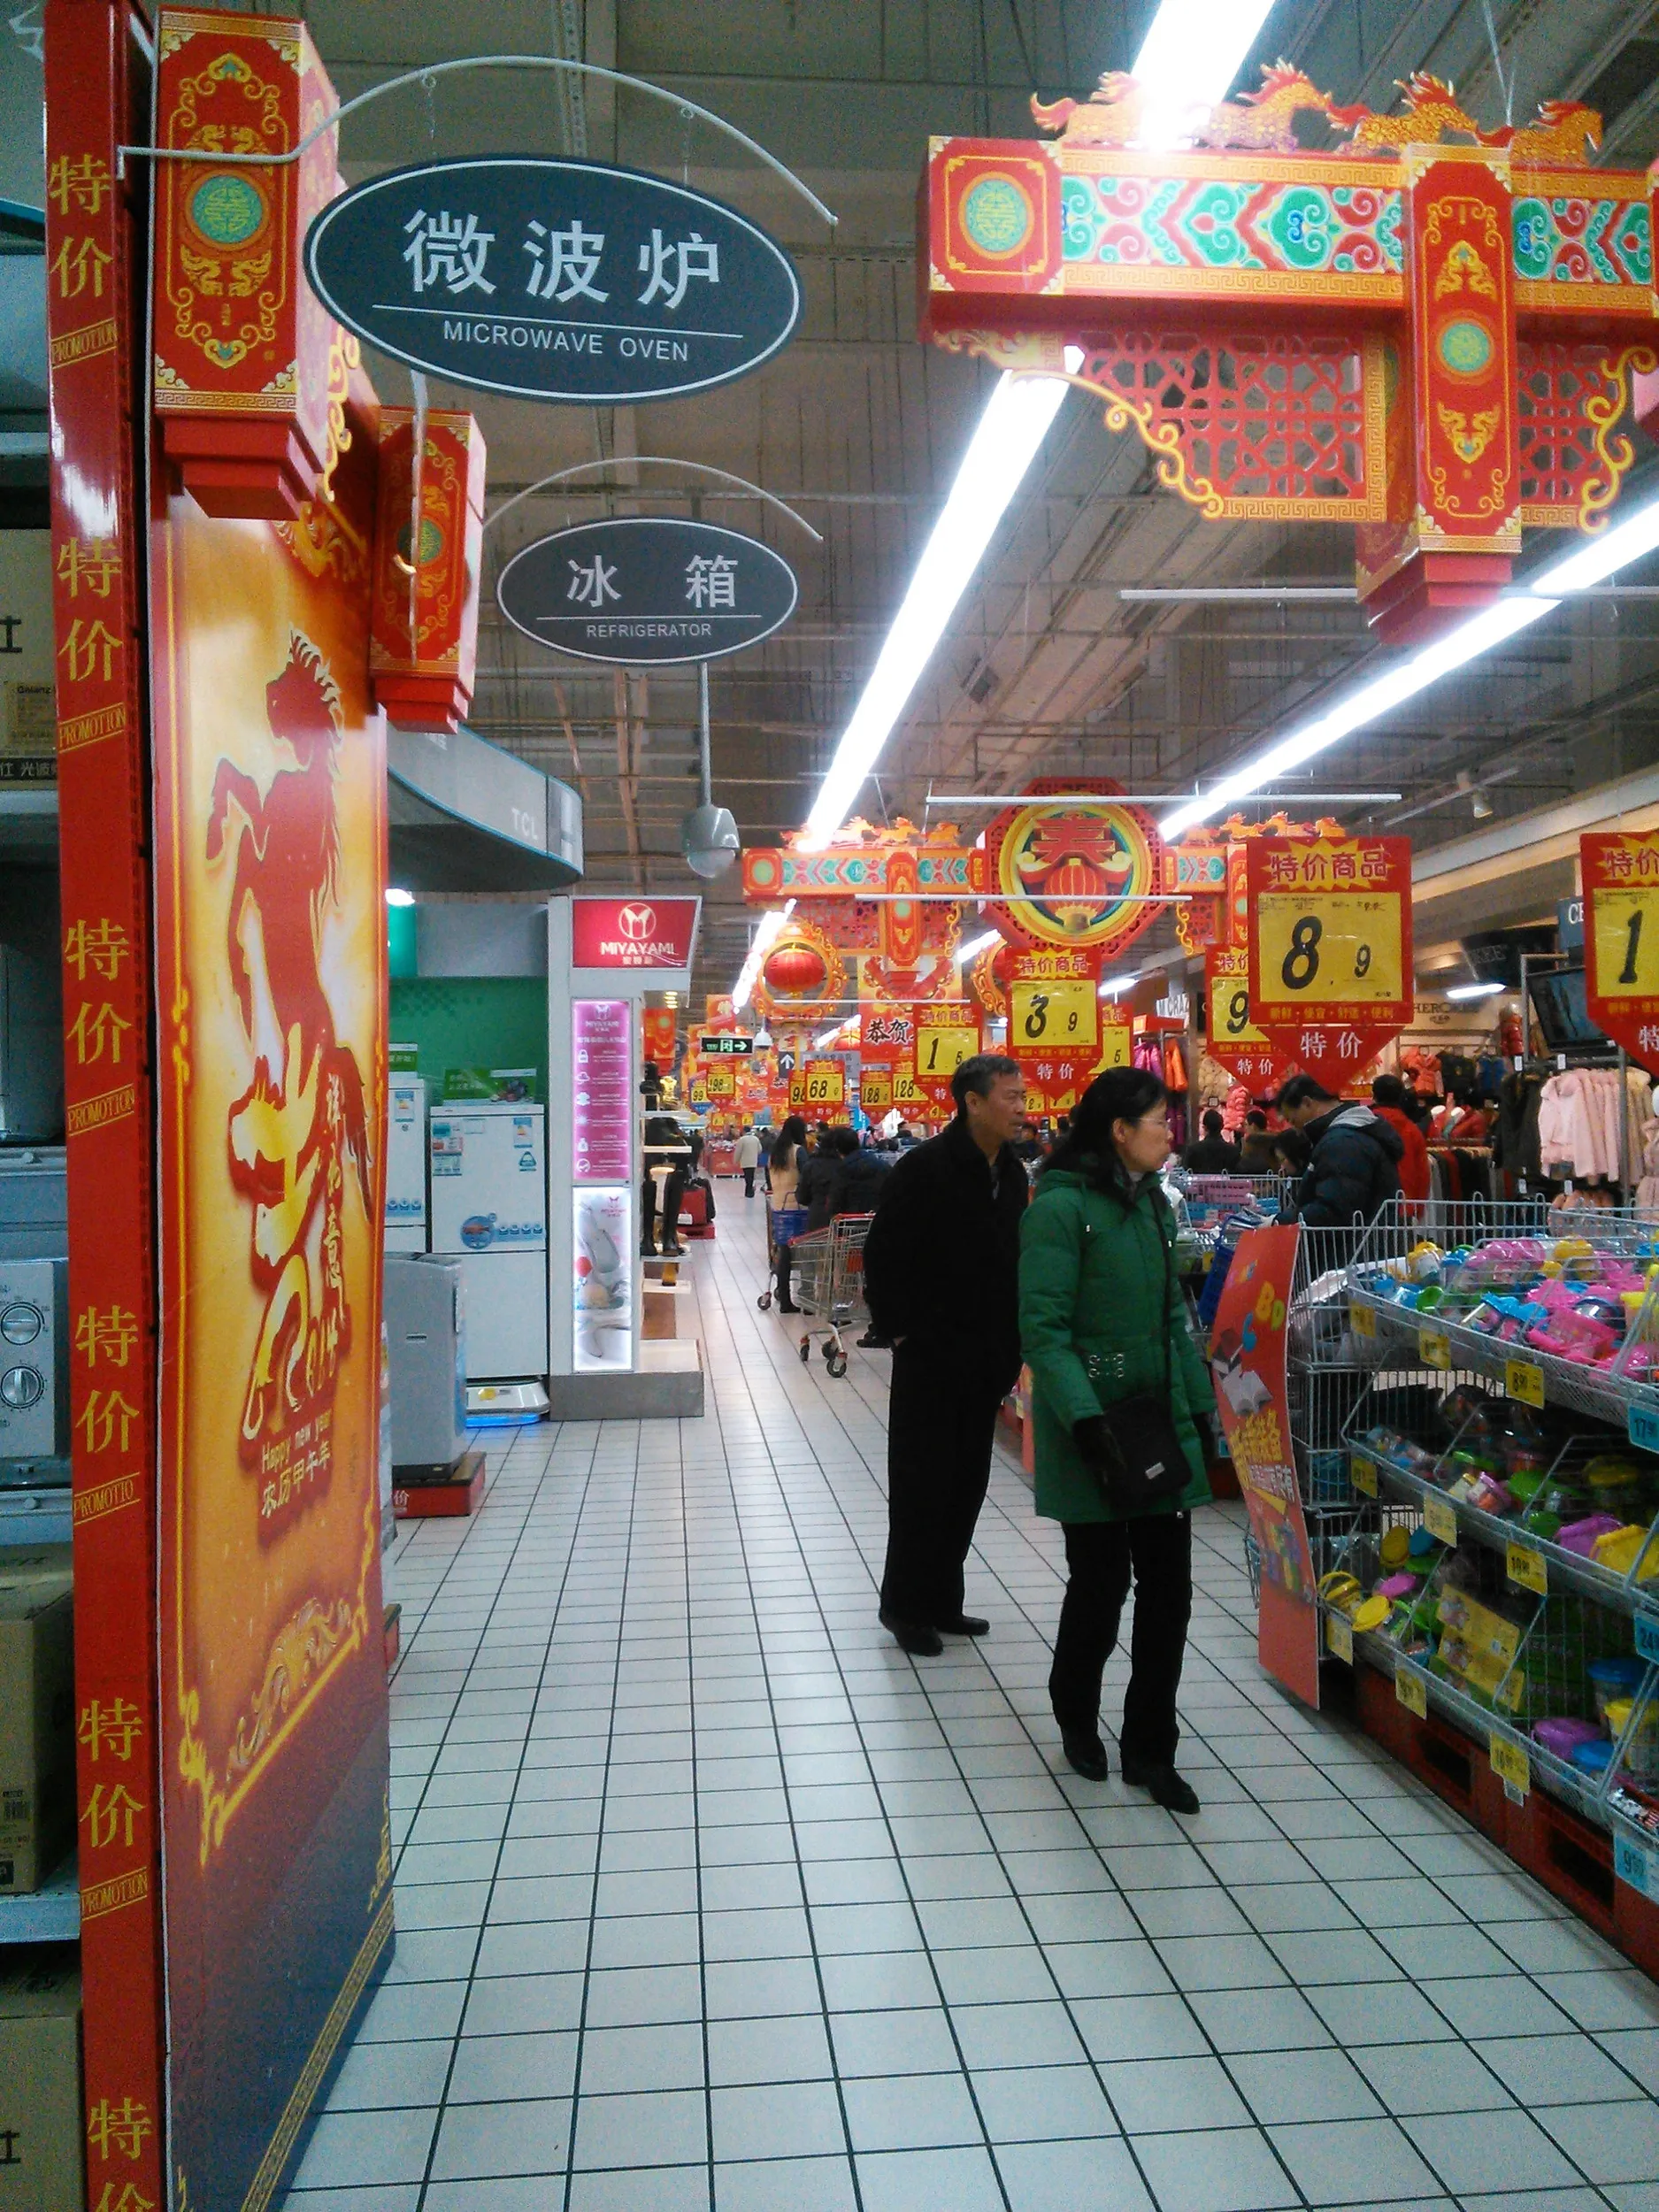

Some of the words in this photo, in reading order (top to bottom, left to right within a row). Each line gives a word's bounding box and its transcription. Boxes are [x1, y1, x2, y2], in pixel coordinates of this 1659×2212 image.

[48, 154, 112, 300] 特价
[402, 209, 721, 310] 微波炉
[52, 319, 118, 362] PROMOTION
[443, 319, 603, 355] MICROWAVE
[619, 336, 689, 364] OVEN
[58, 537, 124, 682] 特价
[586, 621, 712, 638] REFRIGERATOR
[59, 709, 125, 749] PROMOTION
[511, 807, 539, 841] TCL
[1270, 847, 1389, 883] 特价商品
[1605, 848, 1659, 879] 特价
[601, 941, 674, 955] MIYAYAMI
[1020, 955, 1088, 973] 特价商品
[1618, 909, 1643, 984] 1
[65, 918, 134, 1065] 特价
[1226, 990, 1248, 1033] 9
[1301, 1031, 1363, 1059] 特价
[1037, 1063, 1074, 1080] 特价
[1237, 1058, 1274, 1076] 特价
[68, 1087, 134, 1130] PROMOTION
[75, 1305, 140, 1453] 特价
[78, 1697, 146, 1847] 特价
[81, 1870, 148, 1917] PROMOTION
